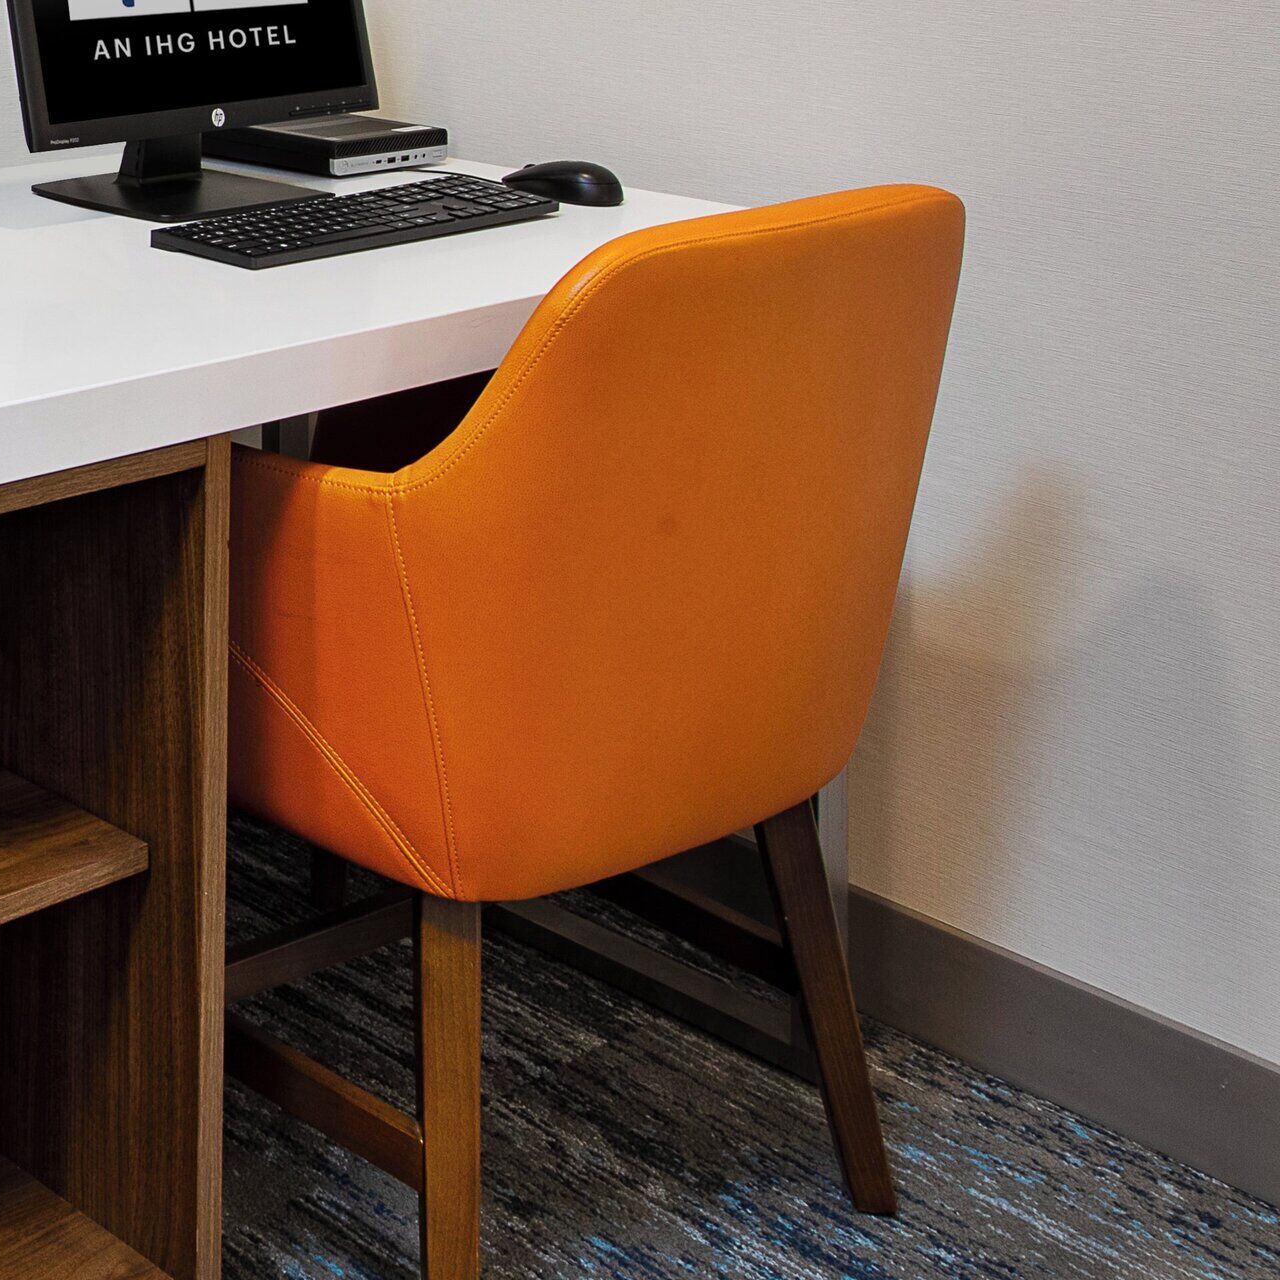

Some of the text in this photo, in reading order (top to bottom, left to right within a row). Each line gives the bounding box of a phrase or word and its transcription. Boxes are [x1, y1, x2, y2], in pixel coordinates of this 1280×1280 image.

[93, 24, 298, 61] AN IHG HOTEL
